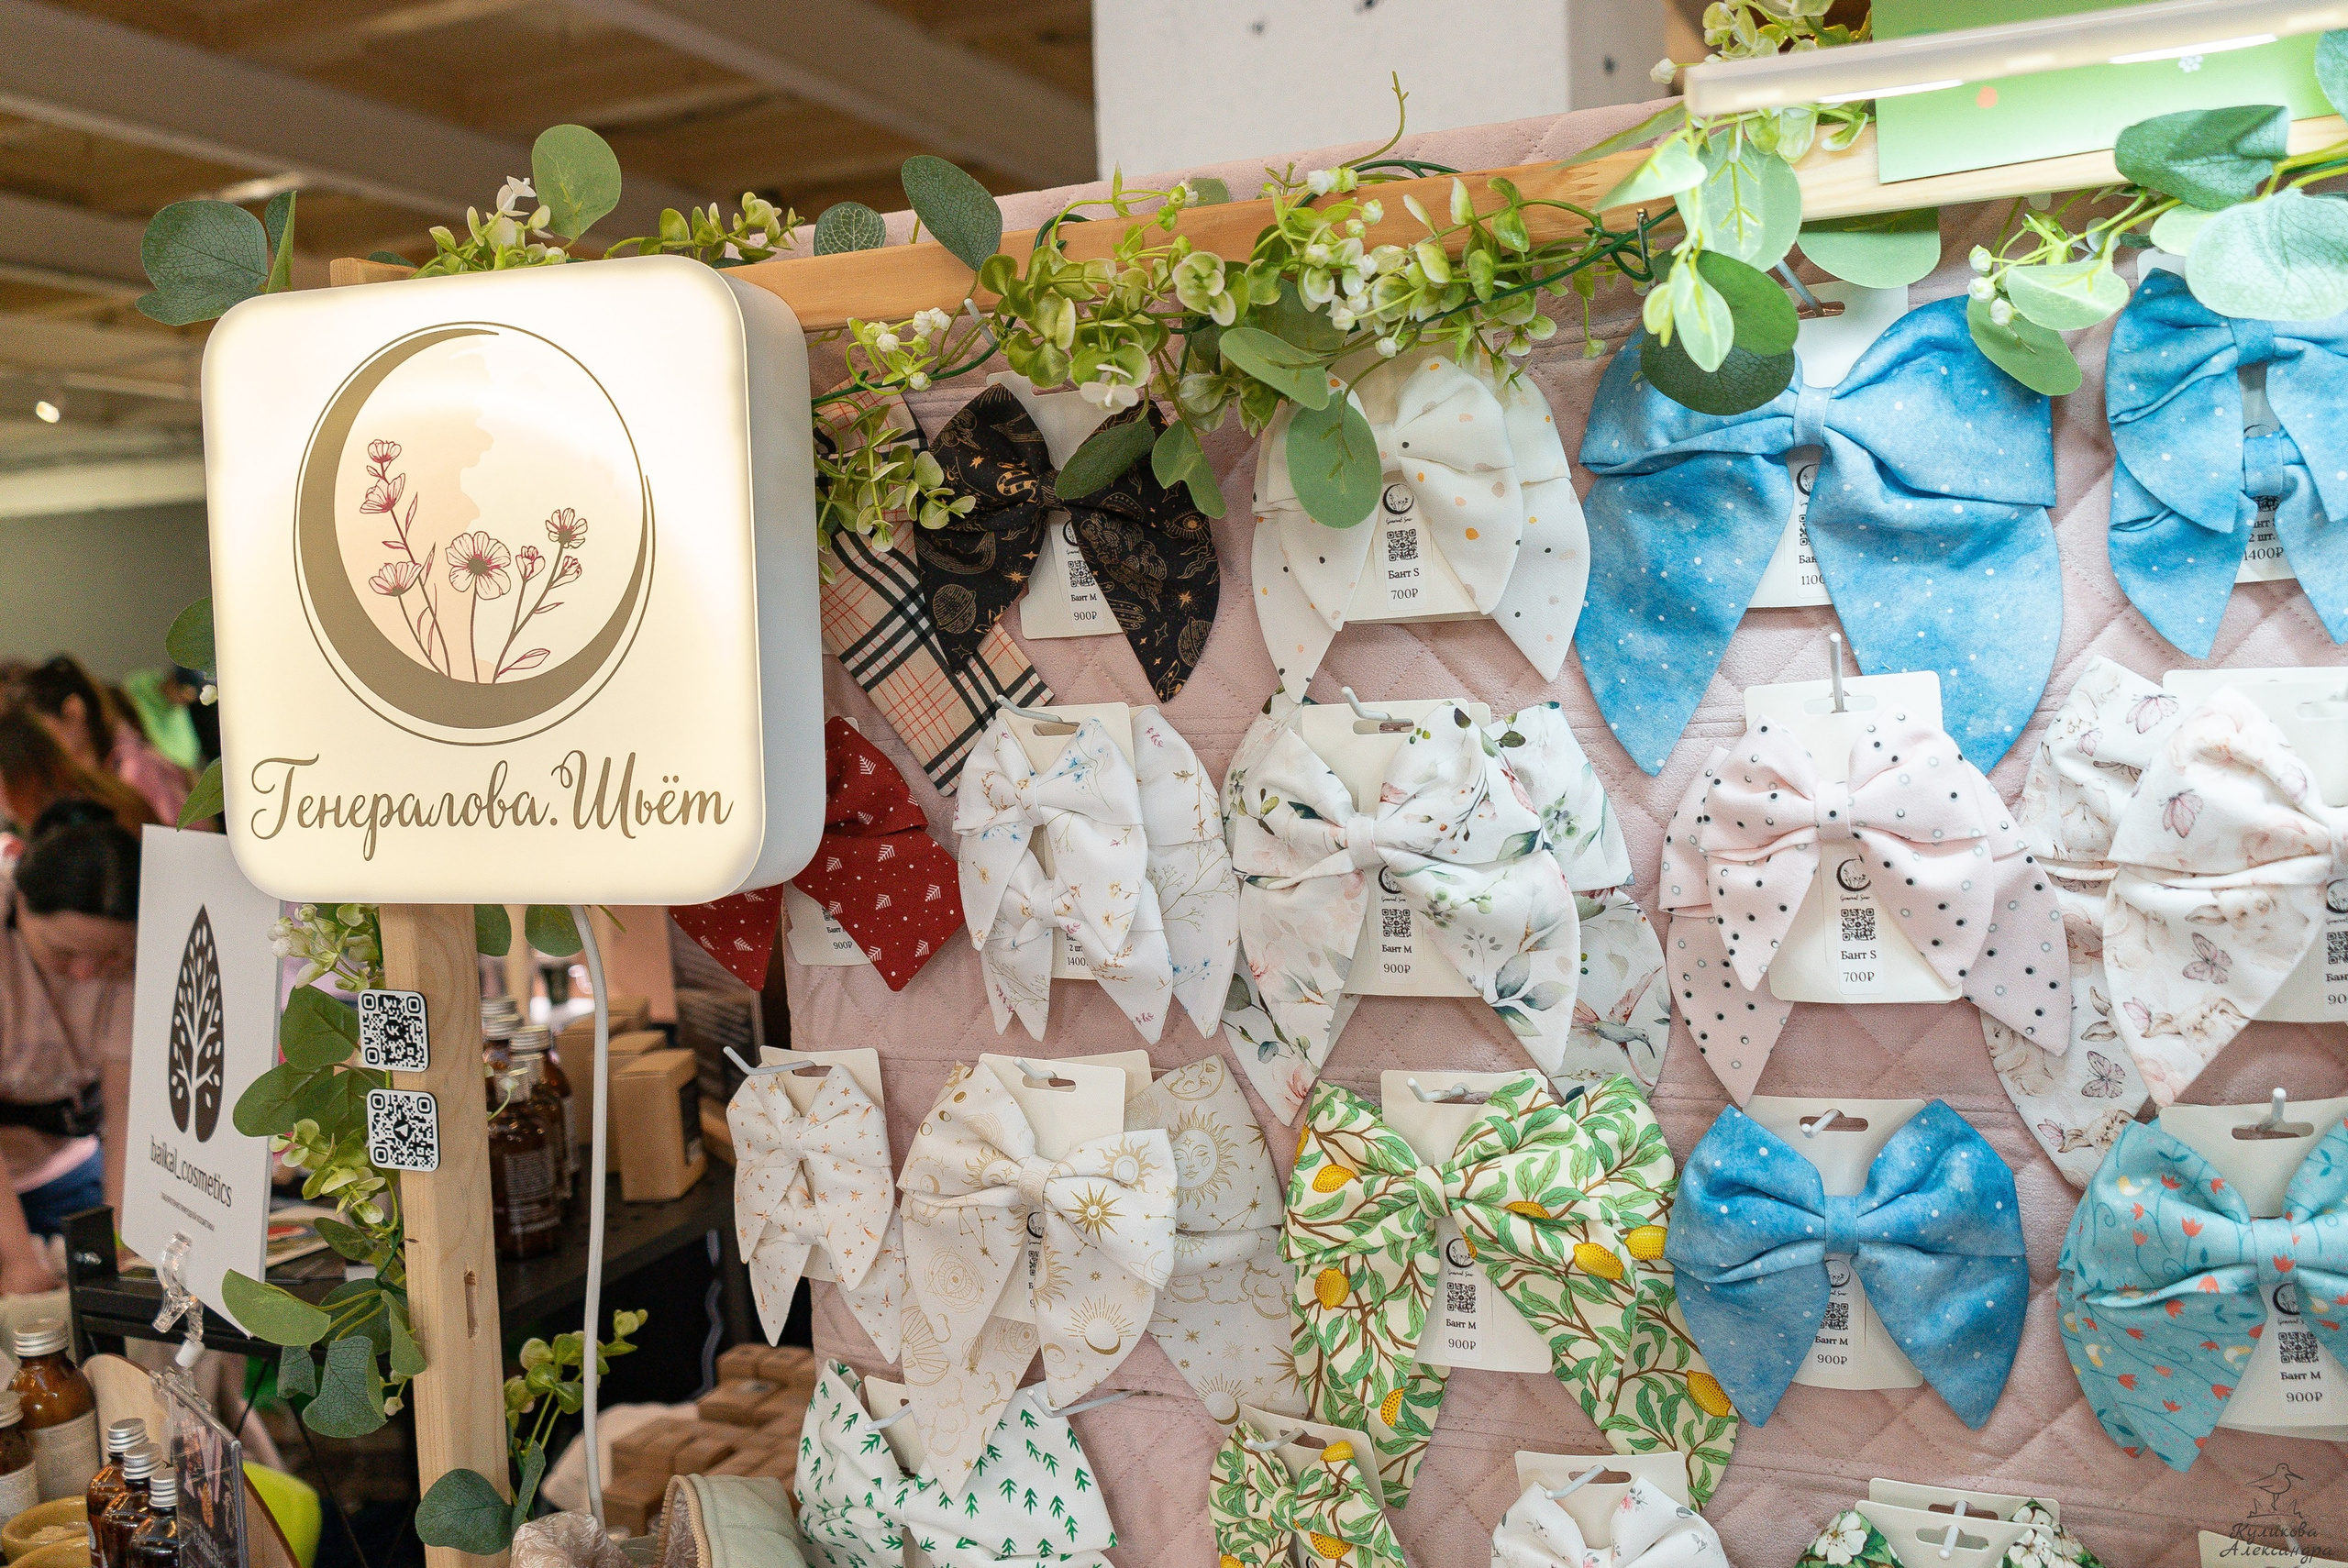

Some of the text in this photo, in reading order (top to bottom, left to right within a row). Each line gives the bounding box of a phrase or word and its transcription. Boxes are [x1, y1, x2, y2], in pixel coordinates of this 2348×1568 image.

[2248, 534, 2255, 542] 2
[1799, 555, 1818, 564] Бан
[1388, 568, 1420, 580] Бант S
[1070, 594, 1088, 602] Бант
[251, 750, 734, 862] Генералова.Шьёт
[1381, 944, 1401, 954] Бант
[1841, 950, 1877, 960] Бант S
[1067, 956, 1089, 966] 1400
[2328, 993, 2347, 1005] 90
[150, 1134, 232, 1208] baikal_cosmetics
[1445, 1319, 1467, 1329] Бант
[1815, 1335, 1837, 1344] Бант
[2280, 1371, 2308, 1380] Бант
